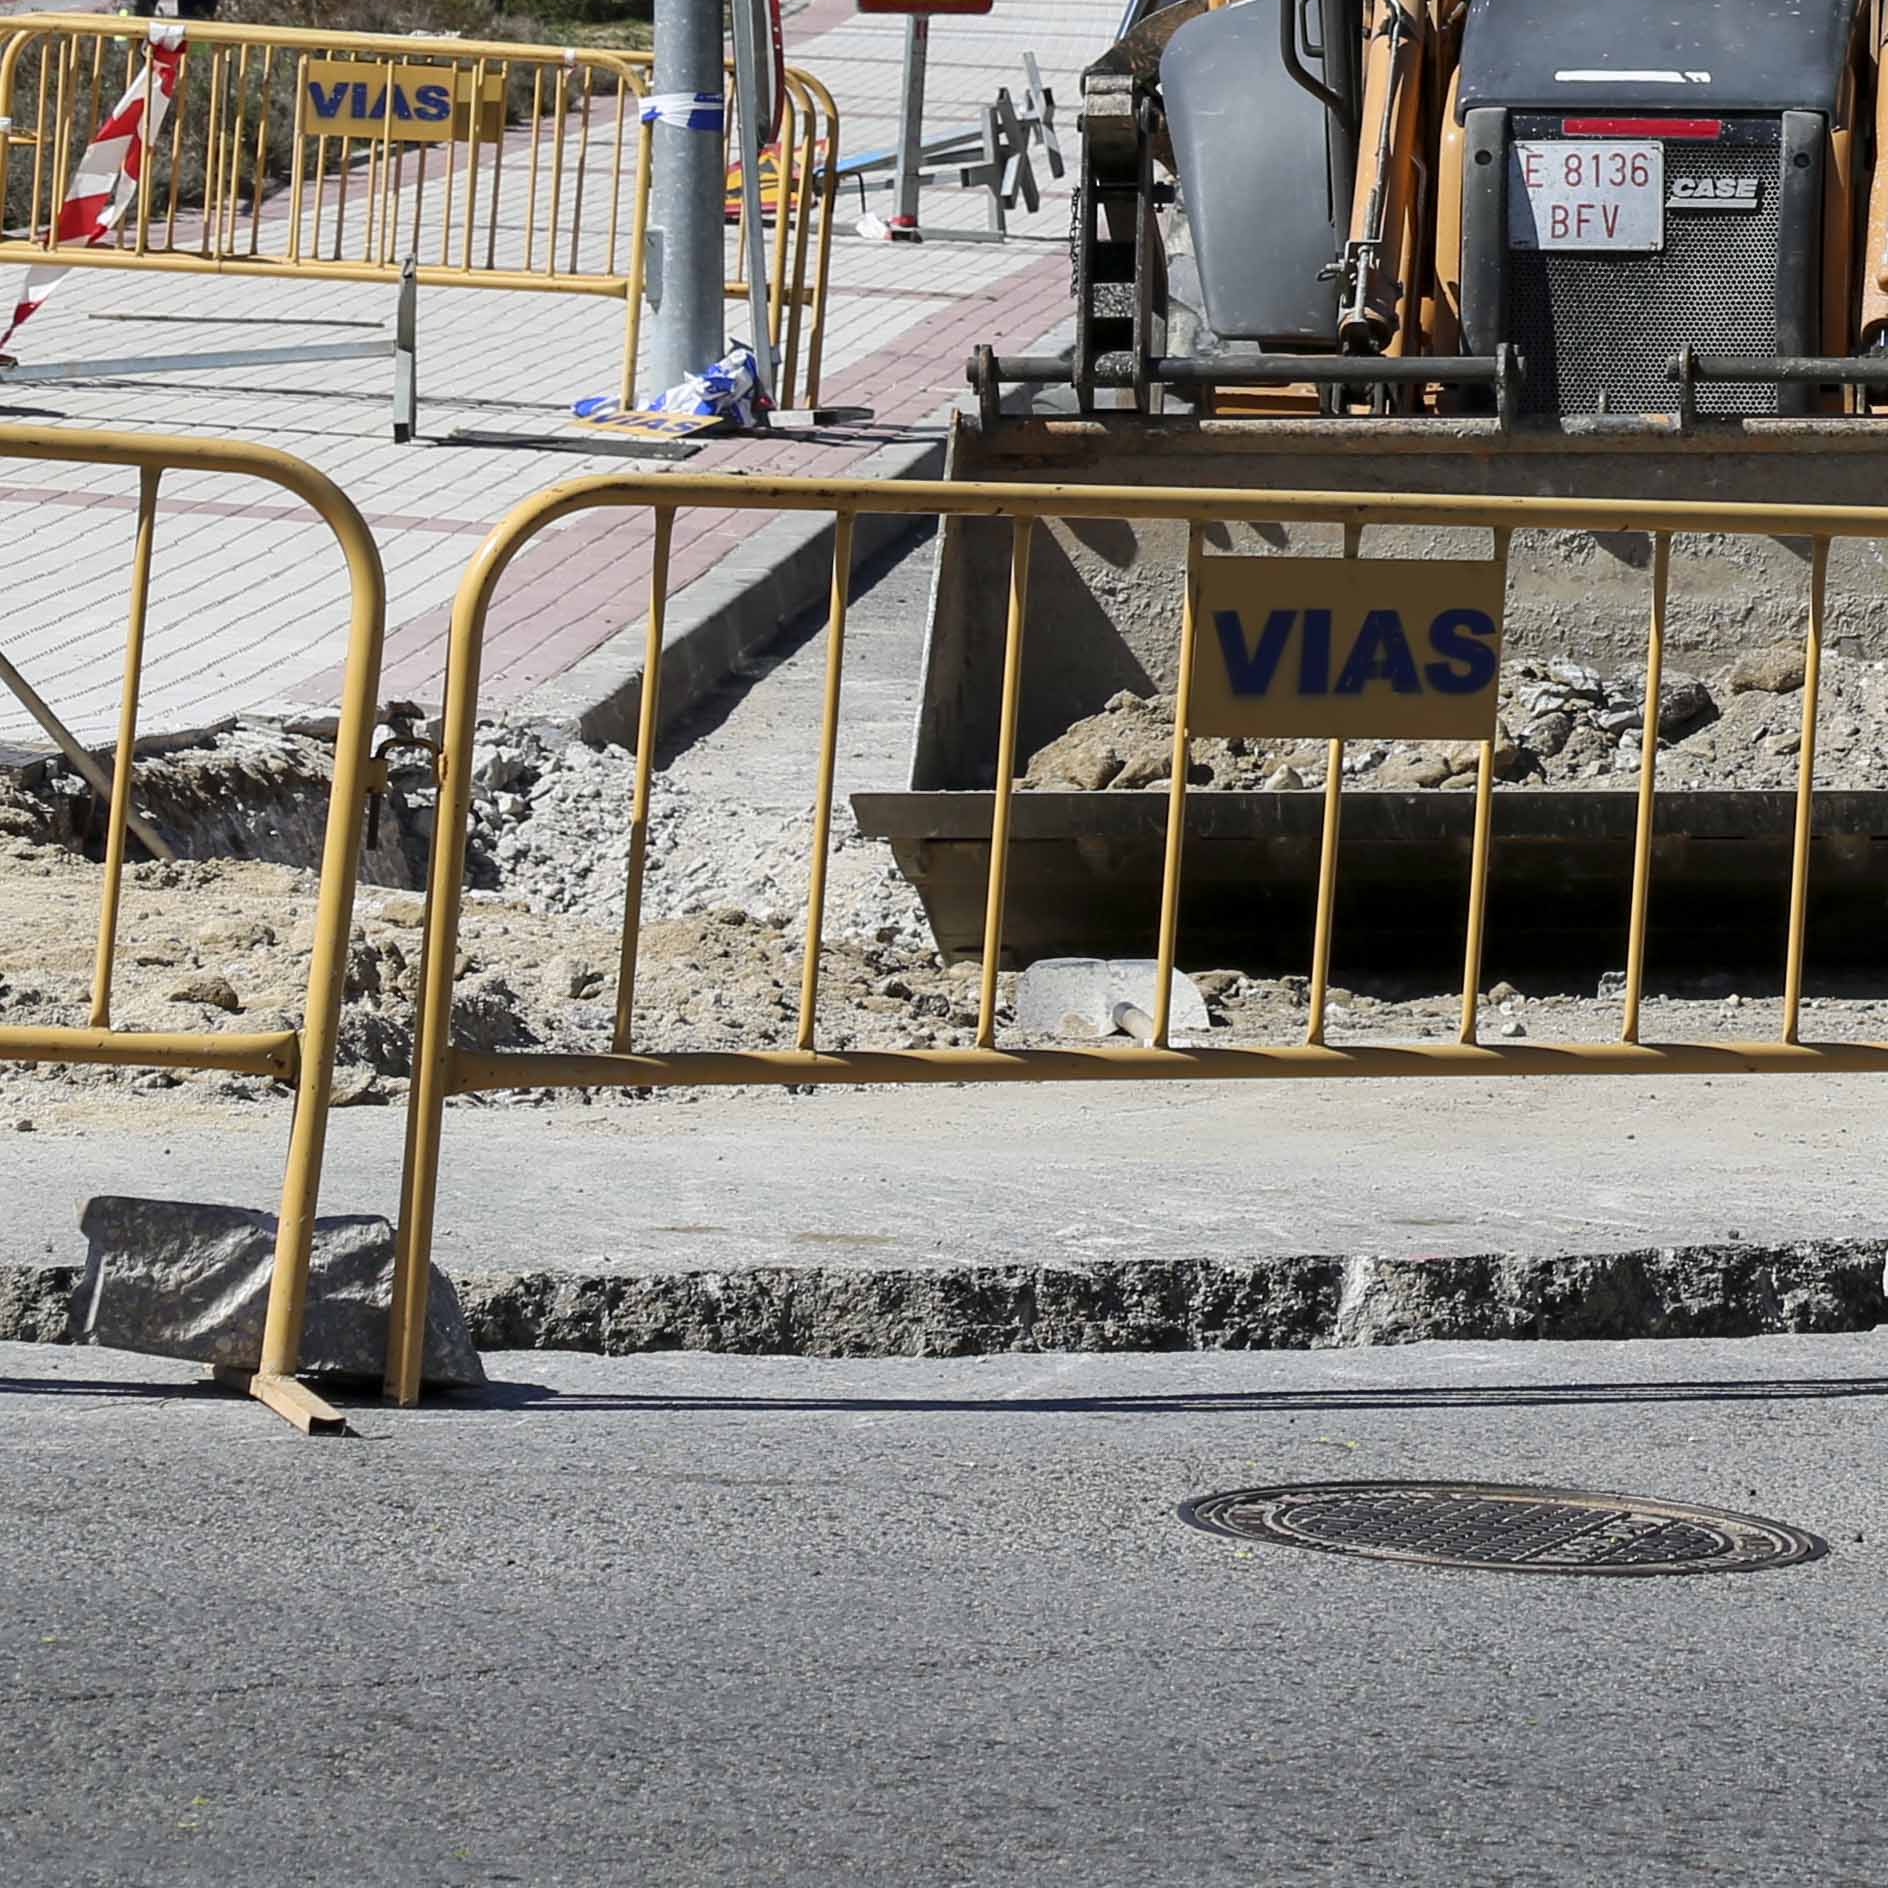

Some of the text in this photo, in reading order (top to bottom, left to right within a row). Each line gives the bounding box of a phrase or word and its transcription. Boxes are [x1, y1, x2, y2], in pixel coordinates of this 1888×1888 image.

[307, 81, 451, 122] VIAS
[1525, 152, 1650, 188] E 8136
[1671, 177, 1760, 200] CASE
[1551, 204, 1620, 240] BFV
[592, 413, 704, 433] VIAS
[1212, 608, 1499, 697] VIAS
